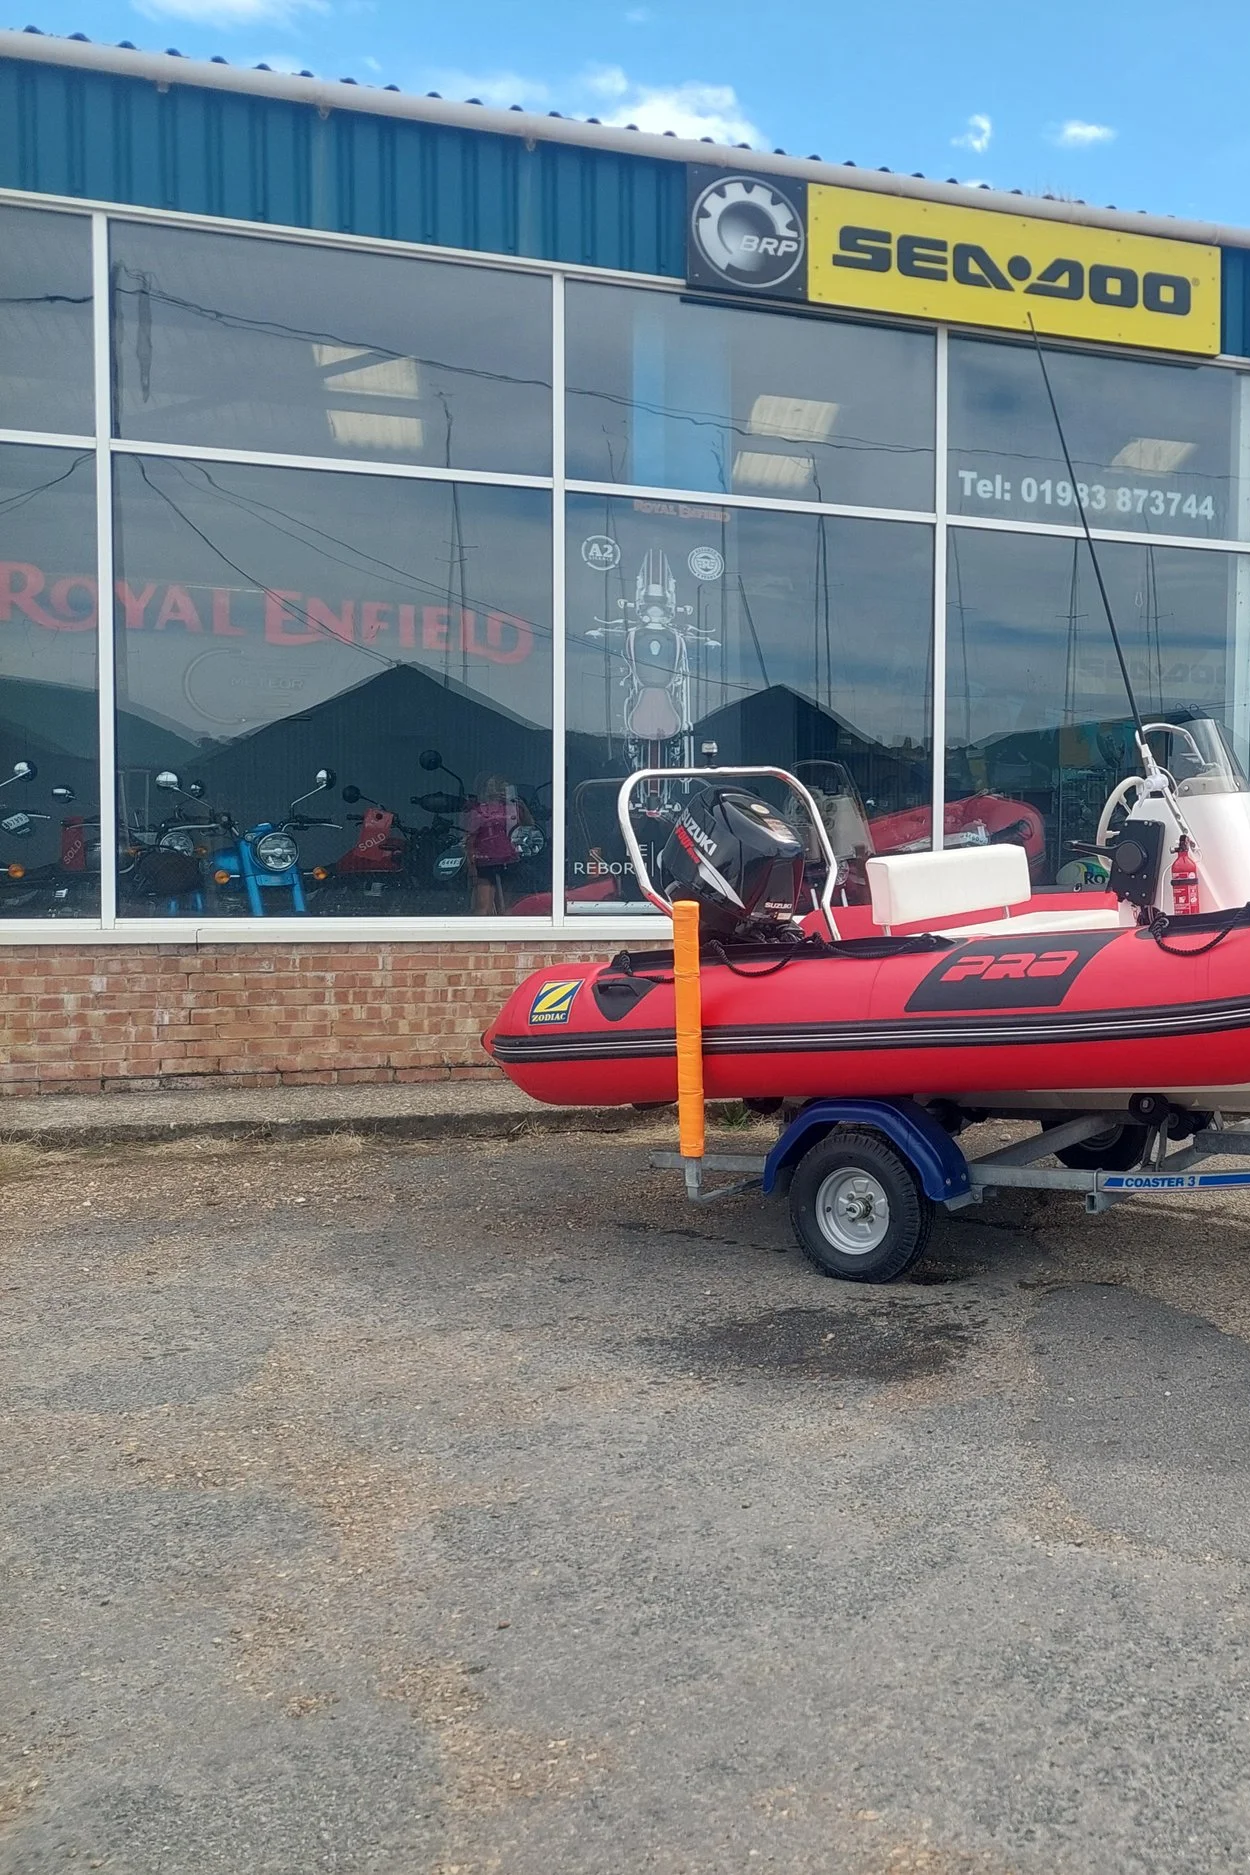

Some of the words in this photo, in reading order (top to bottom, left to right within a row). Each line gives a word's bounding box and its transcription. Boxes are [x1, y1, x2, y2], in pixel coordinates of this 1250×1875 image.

[739, 234, 798, 257] BRP
[958, 470, 1011, 500] Tel:
[1021, 477, 1106, 510] 01983
[1116, 487, 1215, 520] 873744
[589, 543, 614, 558] A2
[0, 560, 245, 636] ROYAL
[265, 583, 533, 664] ENFIELD
[358, 832, 386, 852] SOLD
[682, 808, 717, 856] SUZUKI
[64, 839, 82, 865] SOLD
[940, 950, 1080, 982] PRO
[531, 1013, 567, 1023] ZODIAC
[1125, 1176, 1186, 1188] COASTER
[1188, 1175, 1196, 1187] 3
